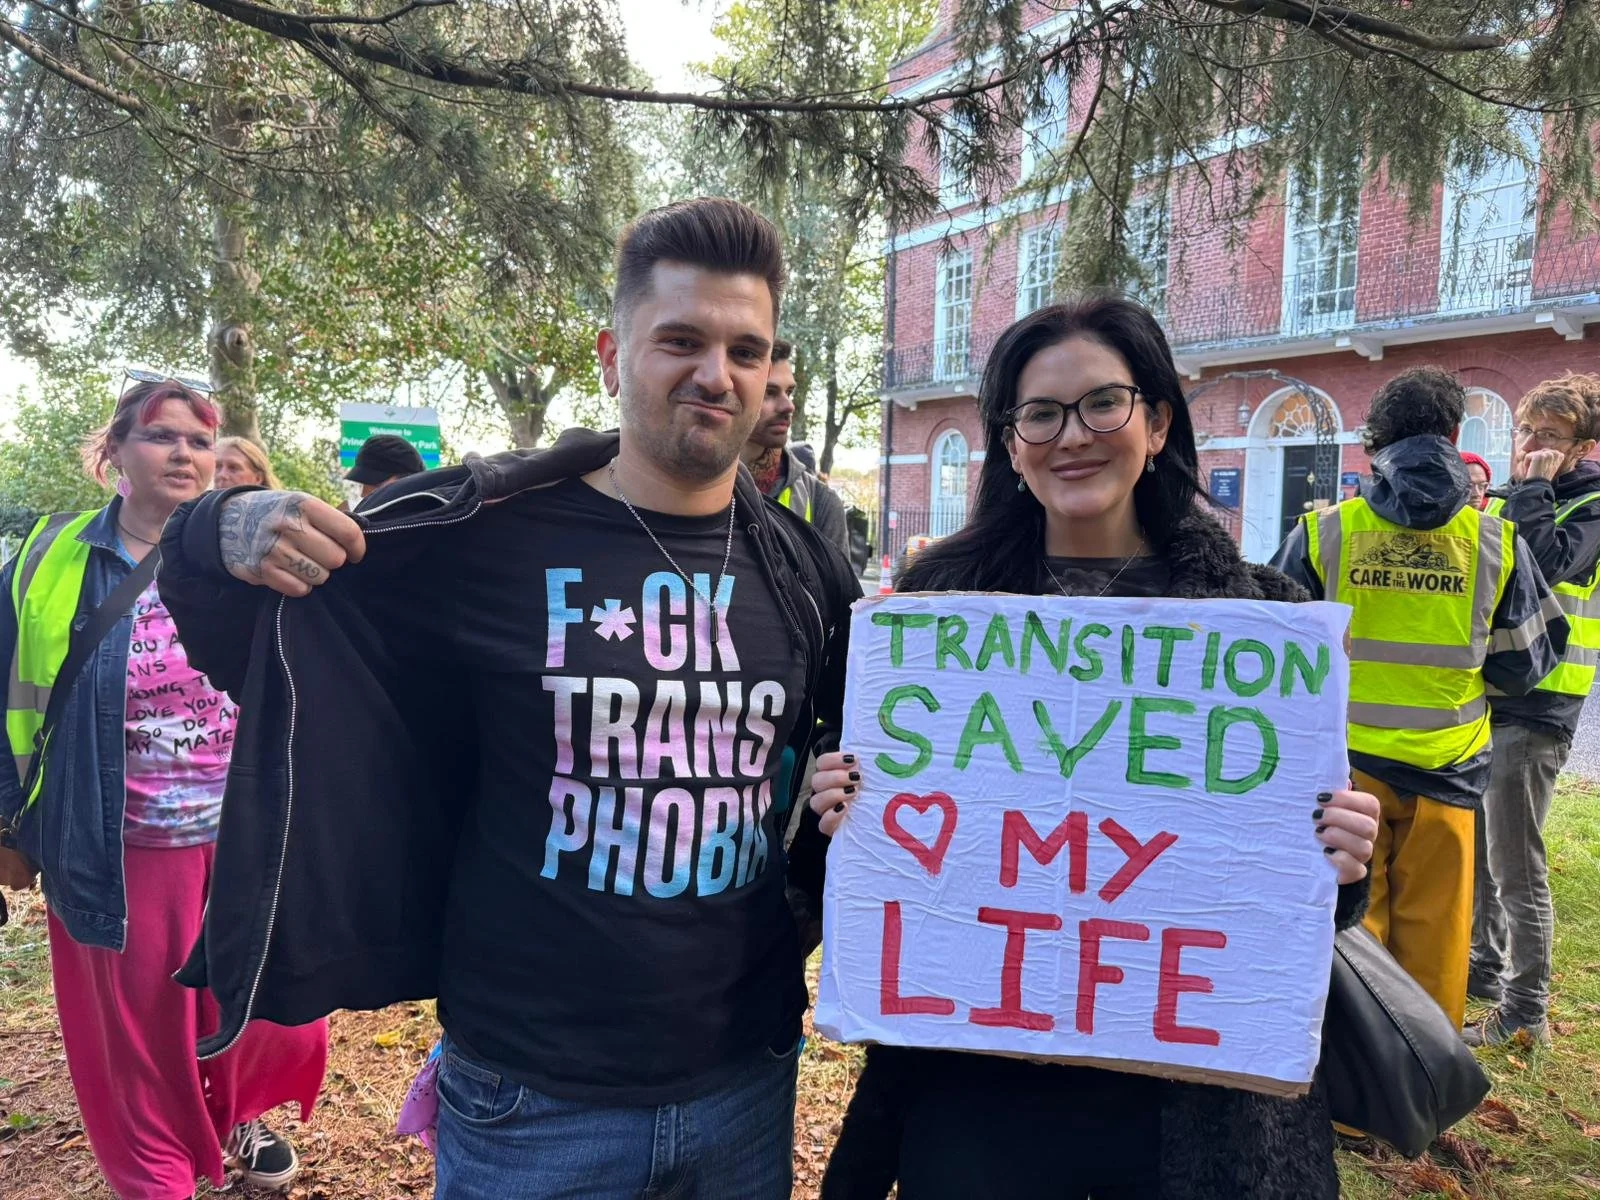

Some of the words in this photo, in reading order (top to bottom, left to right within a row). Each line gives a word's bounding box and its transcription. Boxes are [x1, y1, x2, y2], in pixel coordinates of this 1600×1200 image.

[418, 440, 437, 449] Park
[1349, 568, 1392, 587] CARE
[1392, 579, 1406, 588] THE
[1396, 571, 1404, 579] IS
[1407, 572, 1465, 593] WORK
[129, 640, 157, 656] OU
[871, 610, 1330, 698] TRANSITION
[125, 706, 175, 722] LOVE
[183, 696, 218, 715] YOU
[182, 717, 207, 731] DO
[541, 676, 786, 779] TRANS
[125, 741, 151, 755] MY
[873, 684, 1281, 795] SAVED
[540, 776, 772, 898] PHOBIA
[1000, 810, 1179, 904] MY
[880, 901, 1227, 1047] LIFE
